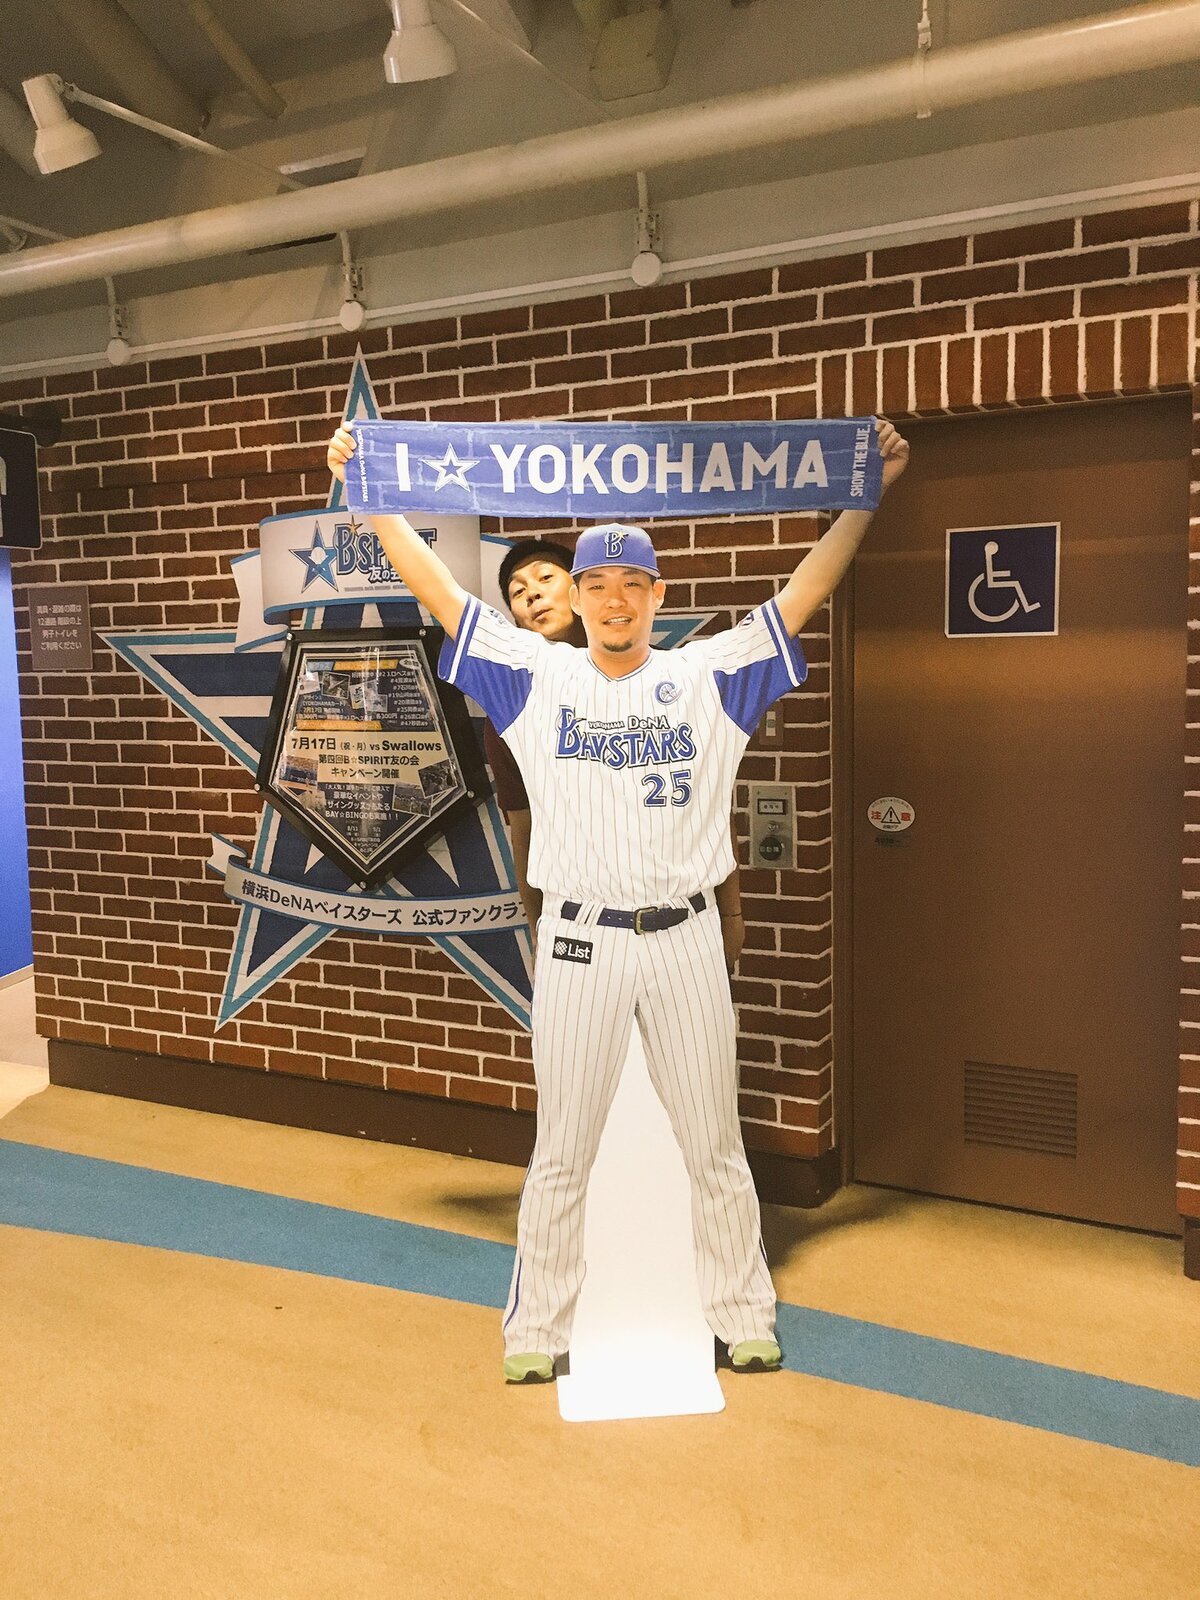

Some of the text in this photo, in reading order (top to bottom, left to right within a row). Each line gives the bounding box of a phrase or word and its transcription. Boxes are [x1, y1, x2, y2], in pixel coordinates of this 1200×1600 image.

[396, 439, 829, 495] I YOKOHAMA
[853, 450, 867, 470] THE
[850, 470, 866, 497] SHOW
[42, 629, 78, 639] 男子トイレを
[588, 715, 670, 730] YOKOHAMA DeNA
[291, 737, 336, 750] 7月17日
[382, 740, 442, 751] Swallows
[555, 705, 696, 770] BAYSTARS
[331, 768, 400, 779] キャンペーン開催
[641, 769, 692, 807] 25
[242, 879, 402, 925] 横浜DeNAベイスターズ
[568, 944, 591, 960] List
